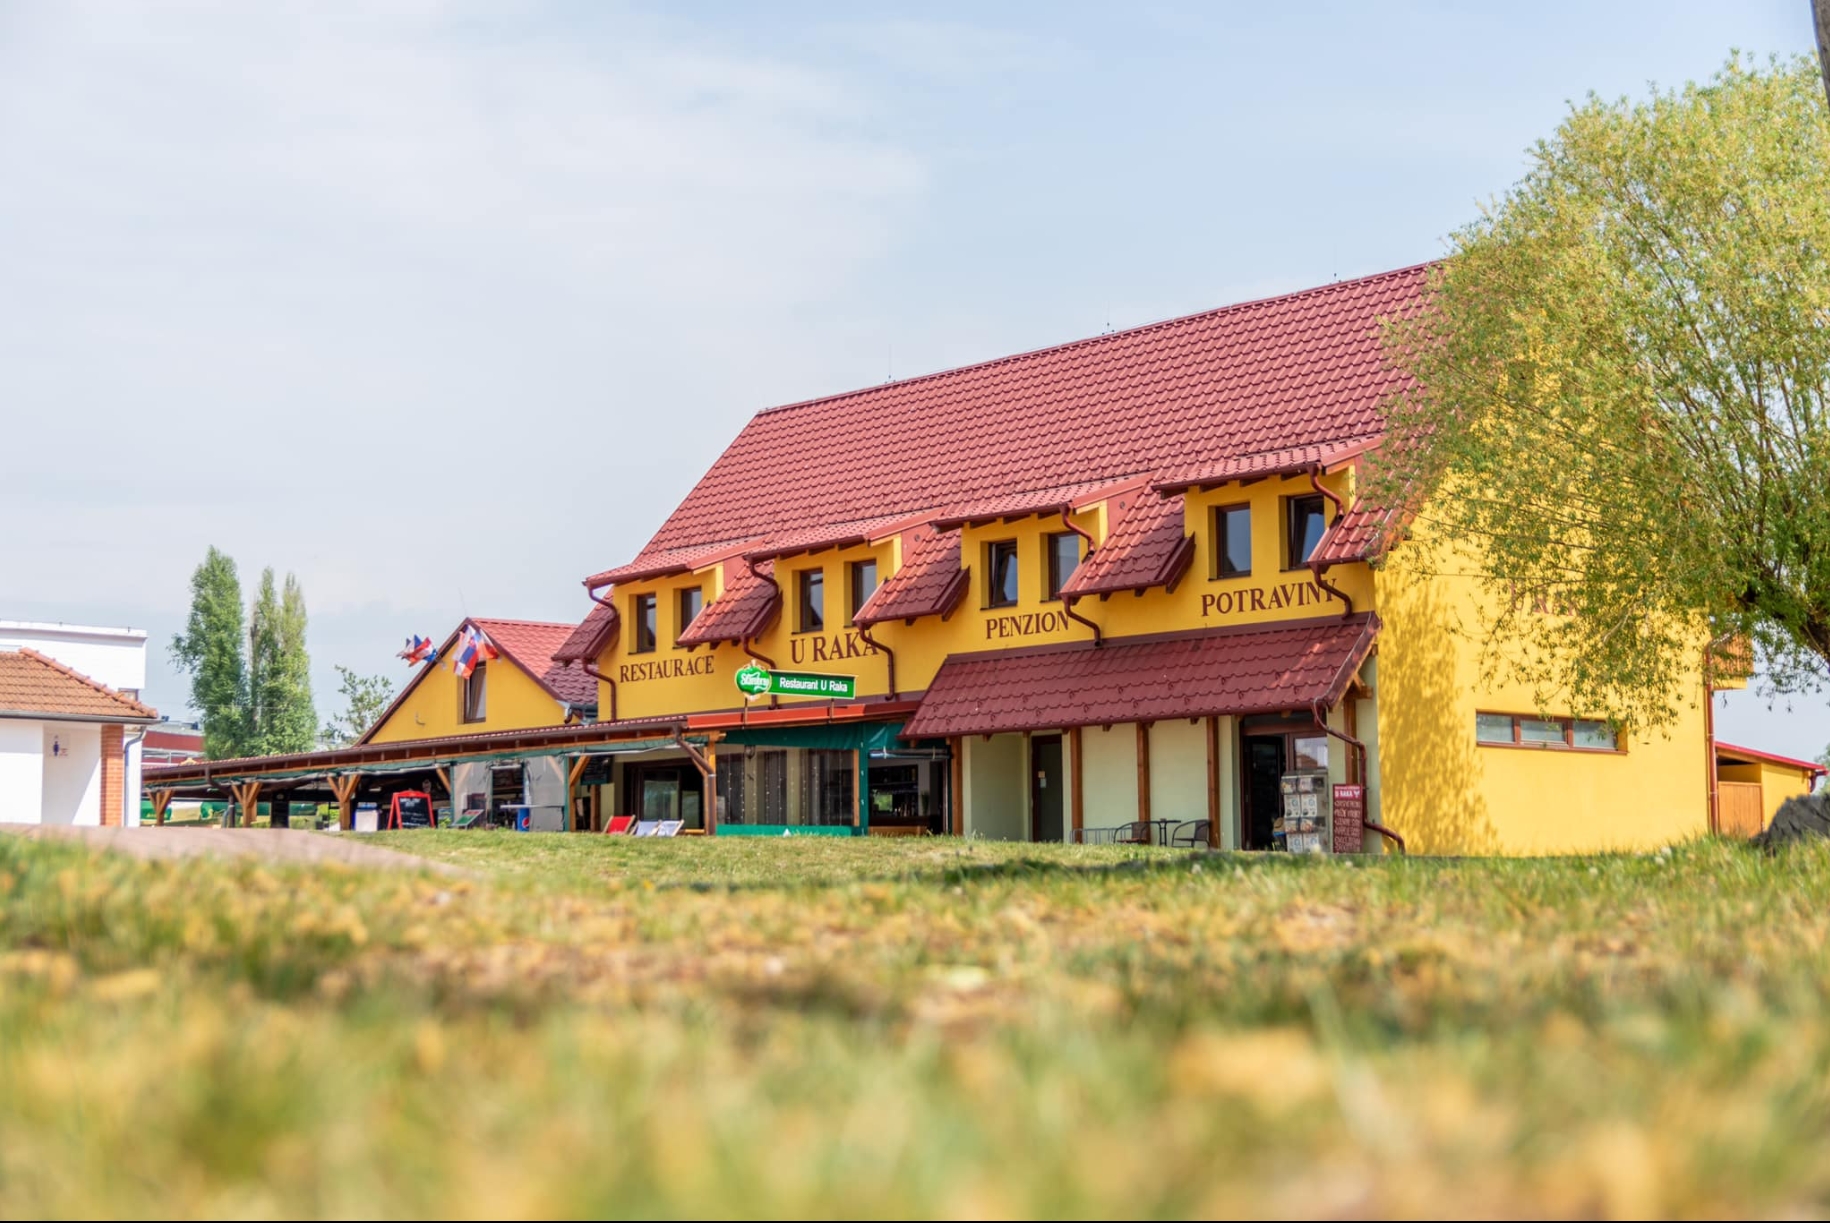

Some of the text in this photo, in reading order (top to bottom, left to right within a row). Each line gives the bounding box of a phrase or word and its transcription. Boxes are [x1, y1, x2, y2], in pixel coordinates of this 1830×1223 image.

[1201, 578, 1337, 617] POTRAVINY
[986, 610, 1069, 640] PENZION
[790, 630, 879, 664] U RAKA
[619, 655, 714, 683] RESTAURACE
[780, 677, 848, 692] Restaurant U Raka
